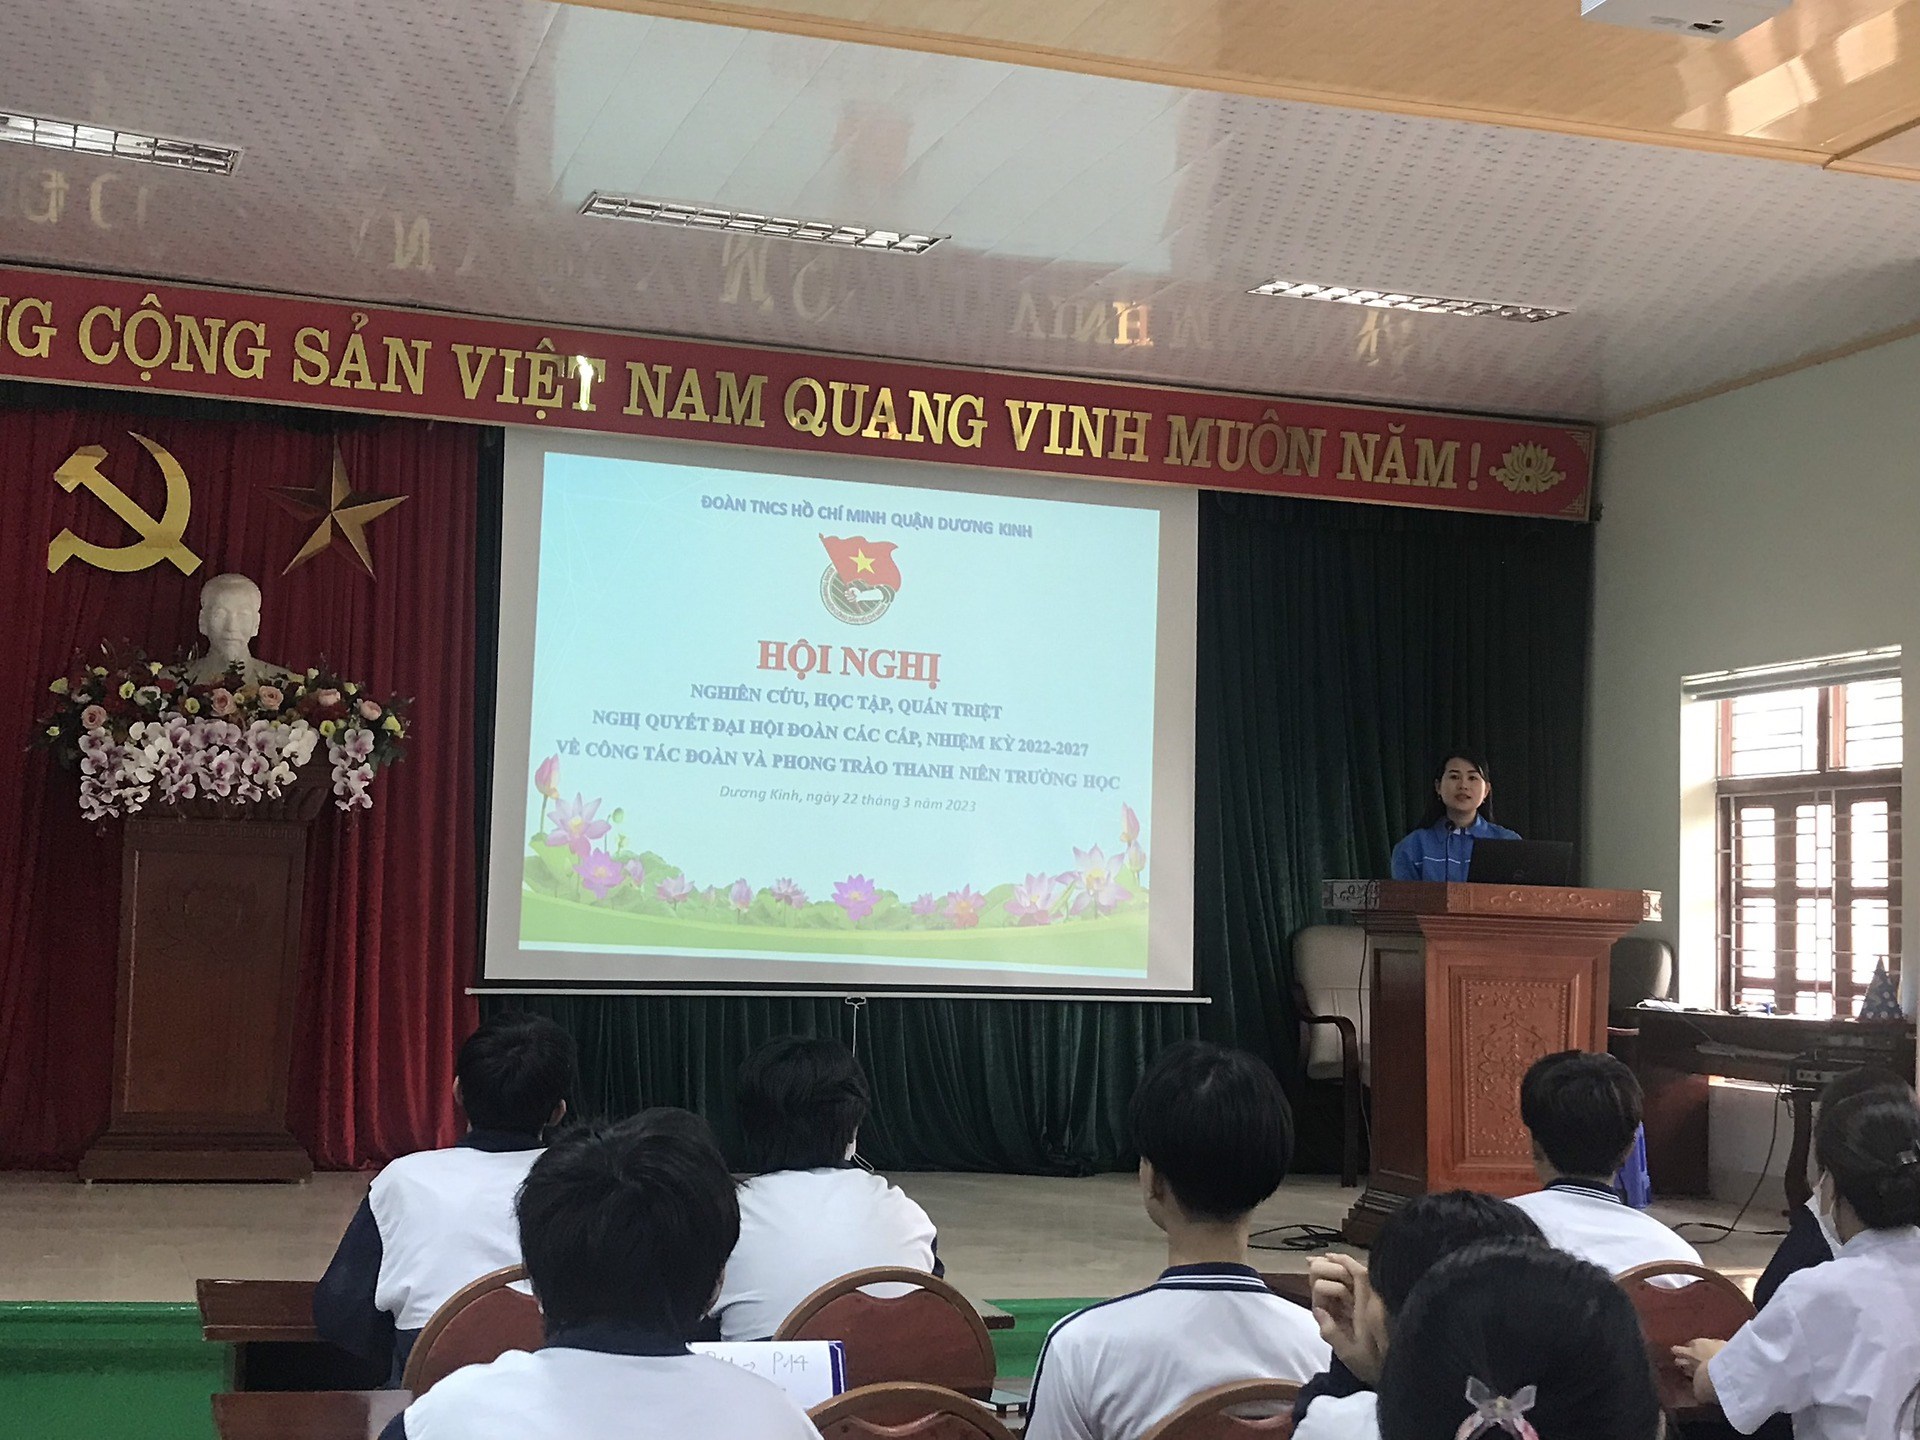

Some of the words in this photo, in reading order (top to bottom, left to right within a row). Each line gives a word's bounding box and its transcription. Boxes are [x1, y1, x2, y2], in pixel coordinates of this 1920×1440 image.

[79, 293, 271, 381] CỘNG
[293, 312, 432, 395] SẢN
[451, 337, 607, 420] VIỆT
[622, 361, 768, 428] NAM
[784, 377, 987, 449] QUANG
[1006, 399, 1152, 463] VINH
[1164, 408, 1326, 478] MUÔN
[1336, 421, 1461, 491] NĂM
[701, 495, 747, 512] ĐOÀN
[750, 500, 788, 517] TNCS
[792, 499, 814, 518] HỒ
[818, 504, 843, 521] CHÍ
[847, 509, 887, 525] MINH
[891, 512, 934, 532] QUẬN
[938, 518, 994, 535] DƯƠNG
[998, 522, 1033, 539] KINH
[757, 638, 833, 681] HỘI
[840, 646, 942, 690] NGHỊ
[690, 683, 762, 702] NGHIÊN
[814, 692, 854, 712] HỌC
[952, 702, 1003, 722] TRIỆT
[592, 709, 641, 730] NGHỊ
[712, 718, 745, 737] ĐẠI
[750, 719, 784, 739] HỘI
[788, 722, 838, 740] ĐOÀN
[843, 725, 881, 743] CÁC
[926, 732, 985, 752] NHIỆM
[989, 734, 1015, 752] KỲ
[1018, 738, 1089, 757] 2022-2027
[585, 739, 639, 760] CÔNG
[643, 743, 681, 763] TÁC
[685, 746, 737, 766] ĐOÀN
[742, 749, 768, 768] VÀ
[772, 753, 836, 772] PHONG
[840, 756, 888, 776] TRÀO
[893, 761, 954, 780] THANH
[959, 764, 1001, 783] NIÊN
[1005, 768, 1078, 788] TRƯỜNG
[1083, 774, 1121, 792] HỌC
[719, 785, 767, 803] Dương
[770, 788, 804, 805] Kinh,
[806, 790, 840, 808] ngày
[842, 793, 858, 805] 22
[861, 794, 900, 811] tháng
[903, 797, 912, 808] 3
[914, 799, 943, 810] năm
[946, 800, 977, 812] 2023
